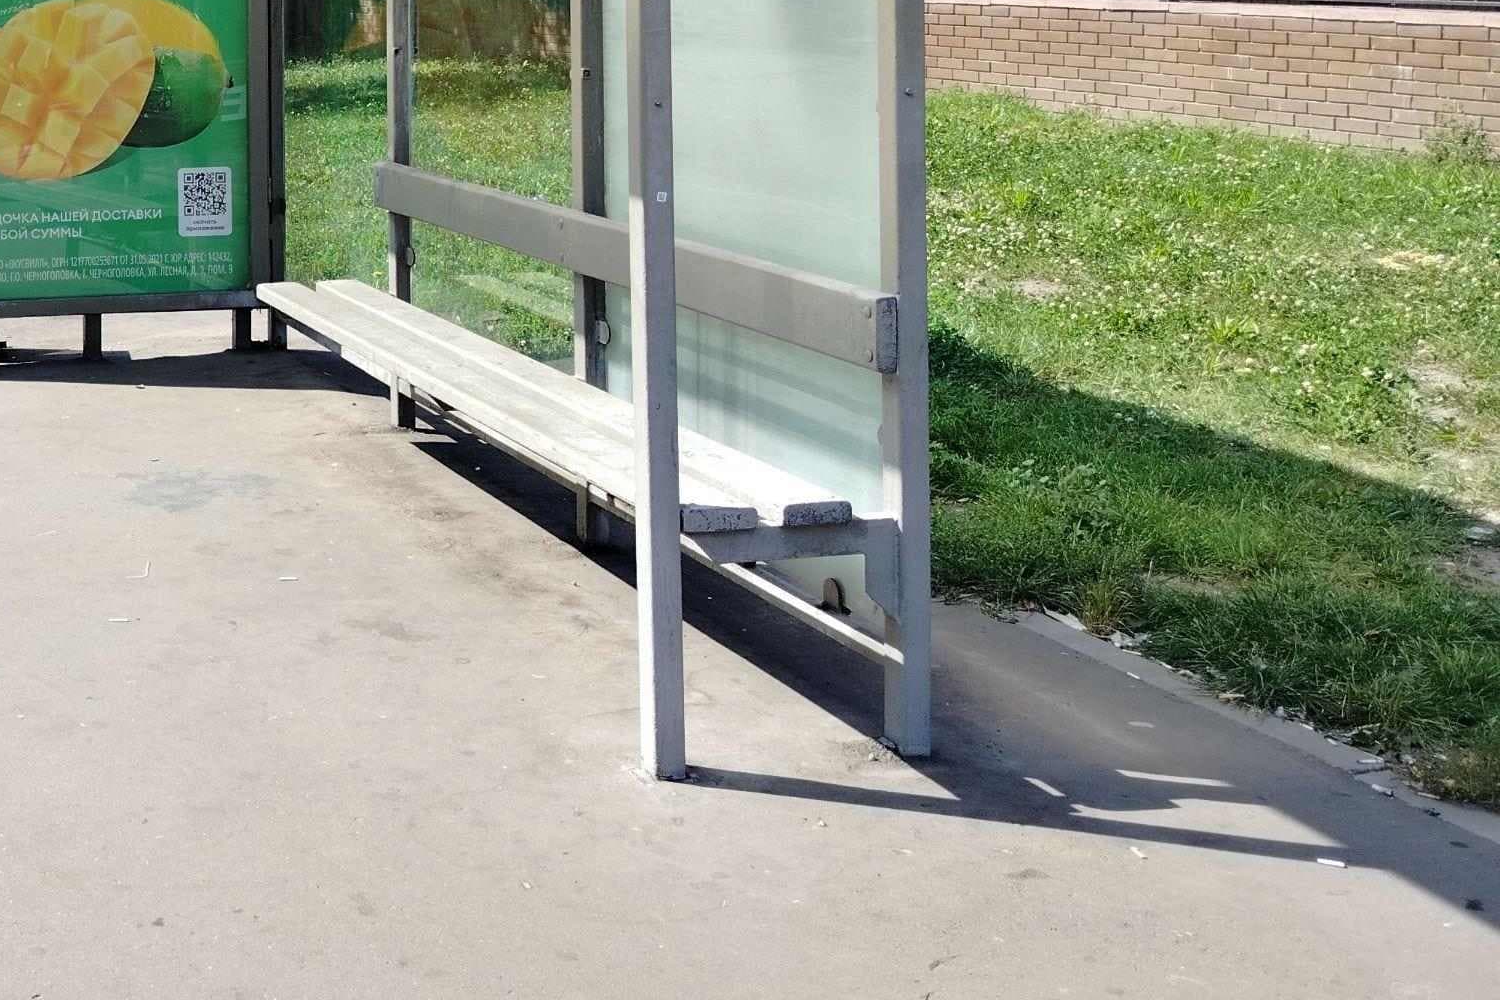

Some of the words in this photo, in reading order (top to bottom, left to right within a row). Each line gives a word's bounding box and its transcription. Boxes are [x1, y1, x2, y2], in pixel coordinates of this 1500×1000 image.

[41, 208, 88, 223] НАШЕЙ
[91, 208, 163, 222] ДОСТАВКИ
[30, 227, 82, 239] СУММЫ
